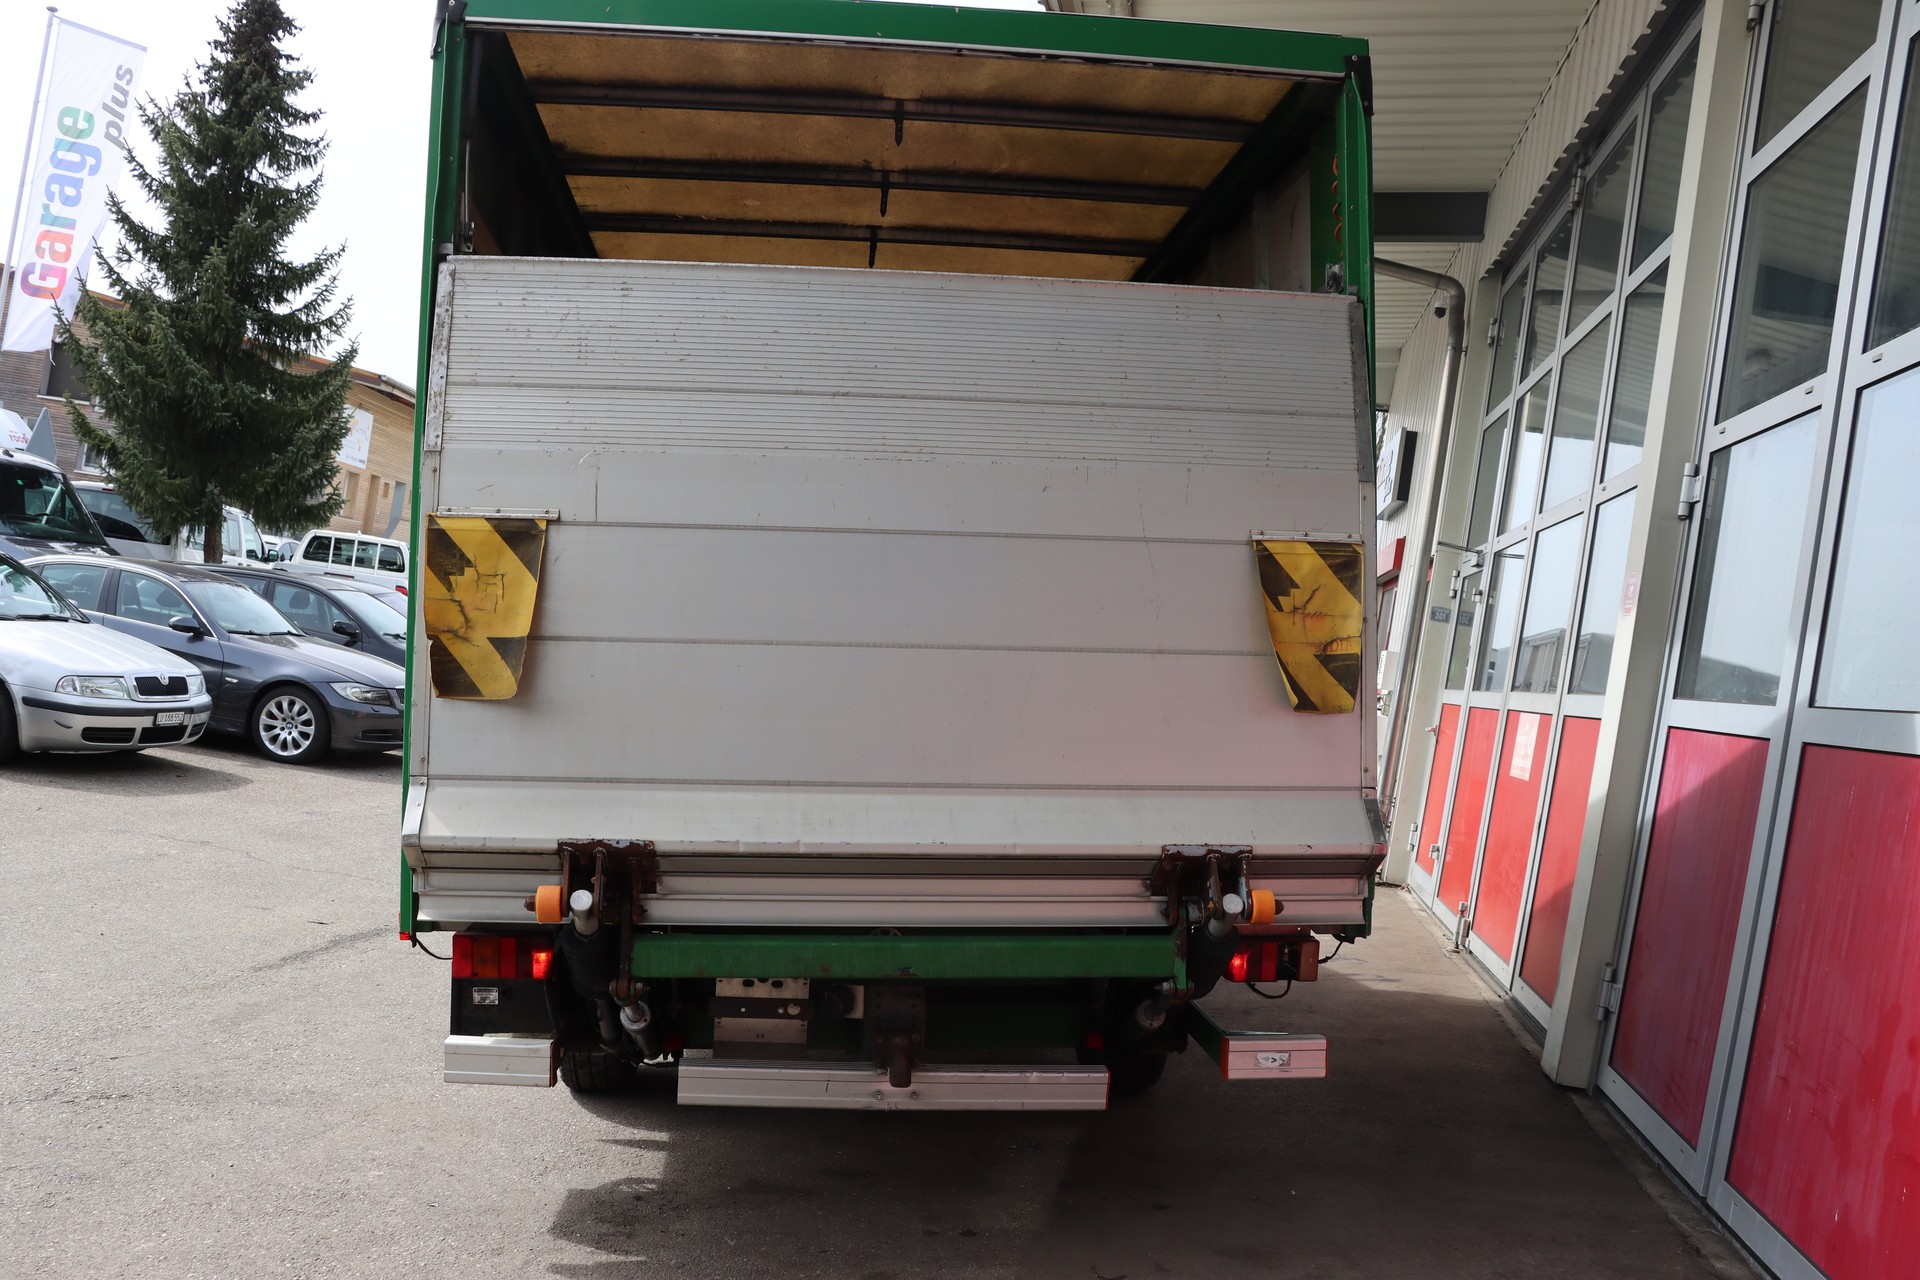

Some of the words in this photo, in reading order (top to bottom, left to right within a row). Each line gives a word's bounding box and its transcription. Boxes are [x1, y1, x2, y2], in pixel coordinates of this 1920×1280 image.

[102, 64, 133, 150] plus
[20, 106, 102, 300] Garage
[1434, 611, 1447, 621] 301
